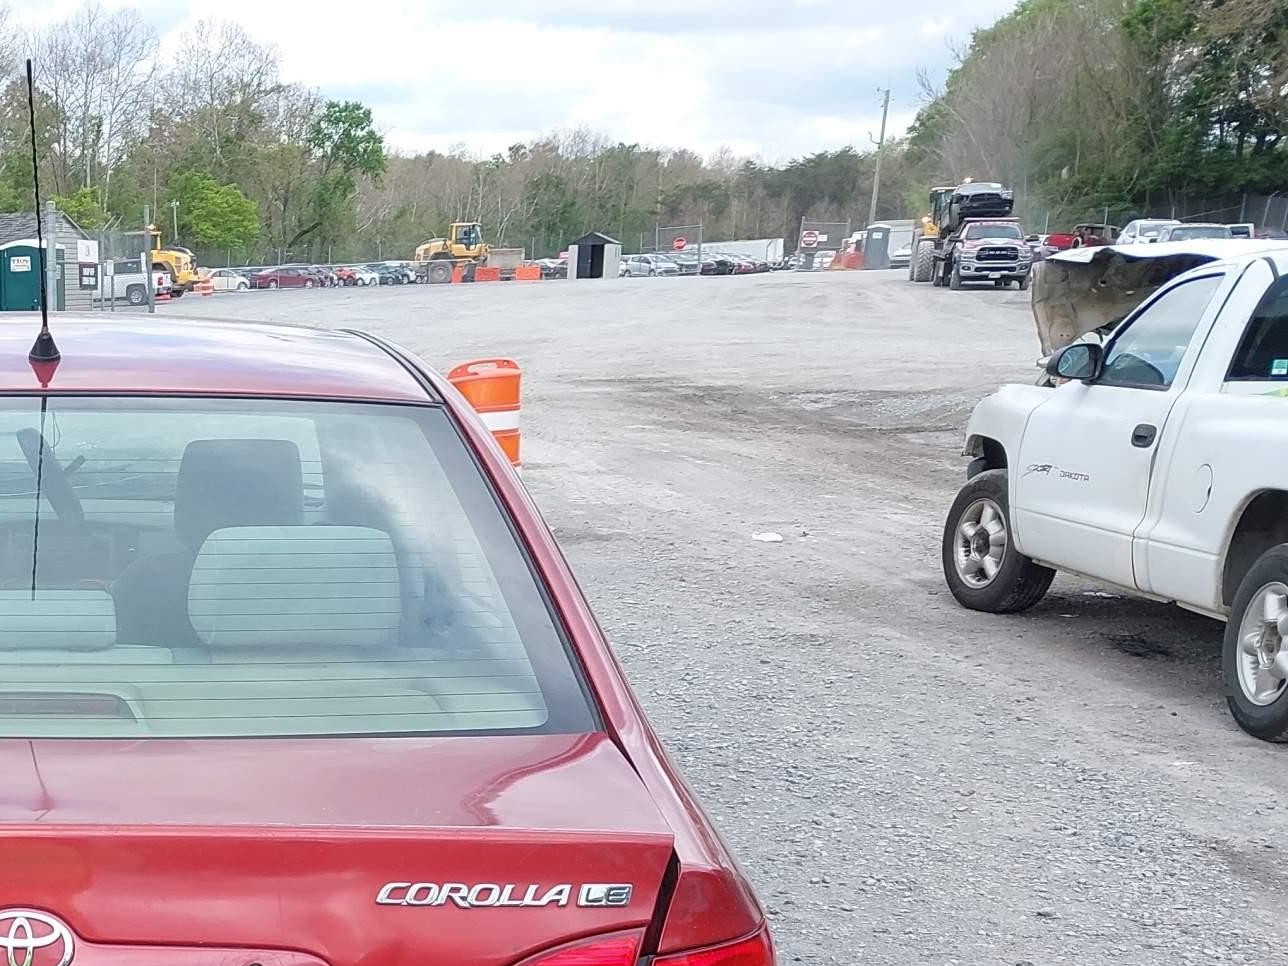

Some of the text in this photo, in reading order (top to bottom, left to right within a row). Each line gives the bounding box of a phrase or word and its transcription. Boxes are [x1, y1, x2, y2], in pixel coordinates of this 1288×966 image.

[1059, 470, 1089, 481] DAKOTA
[375, 882, 632, 908] COROLLA LE
